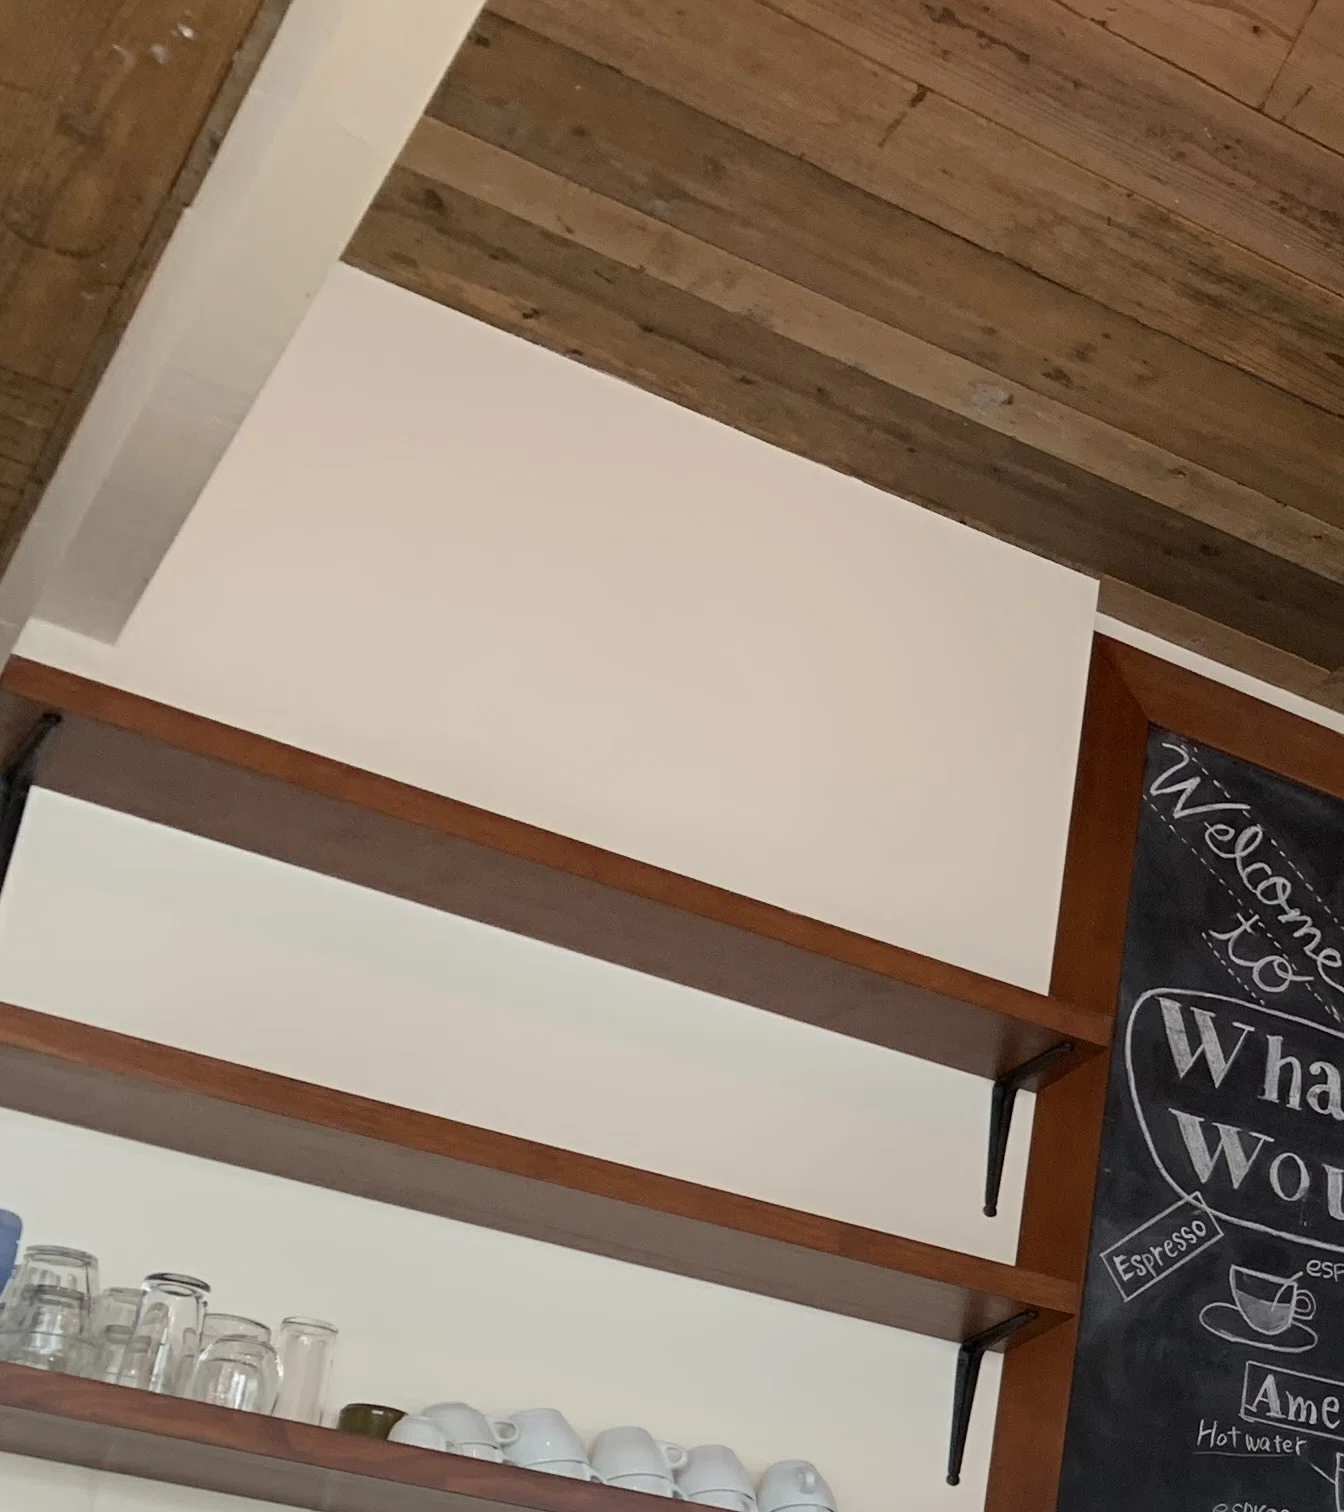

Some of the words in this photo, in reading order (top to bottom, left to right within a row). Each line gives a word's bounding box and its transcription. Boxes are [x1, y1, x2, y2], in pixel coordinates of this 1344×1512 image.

[1211, 911, 1314, 993] to
[1112, 1218, 1208, 1282] Espresso
[1196, 1419, 1239, 1448] Hot
[1245, 1430, 1308, 1455] water
